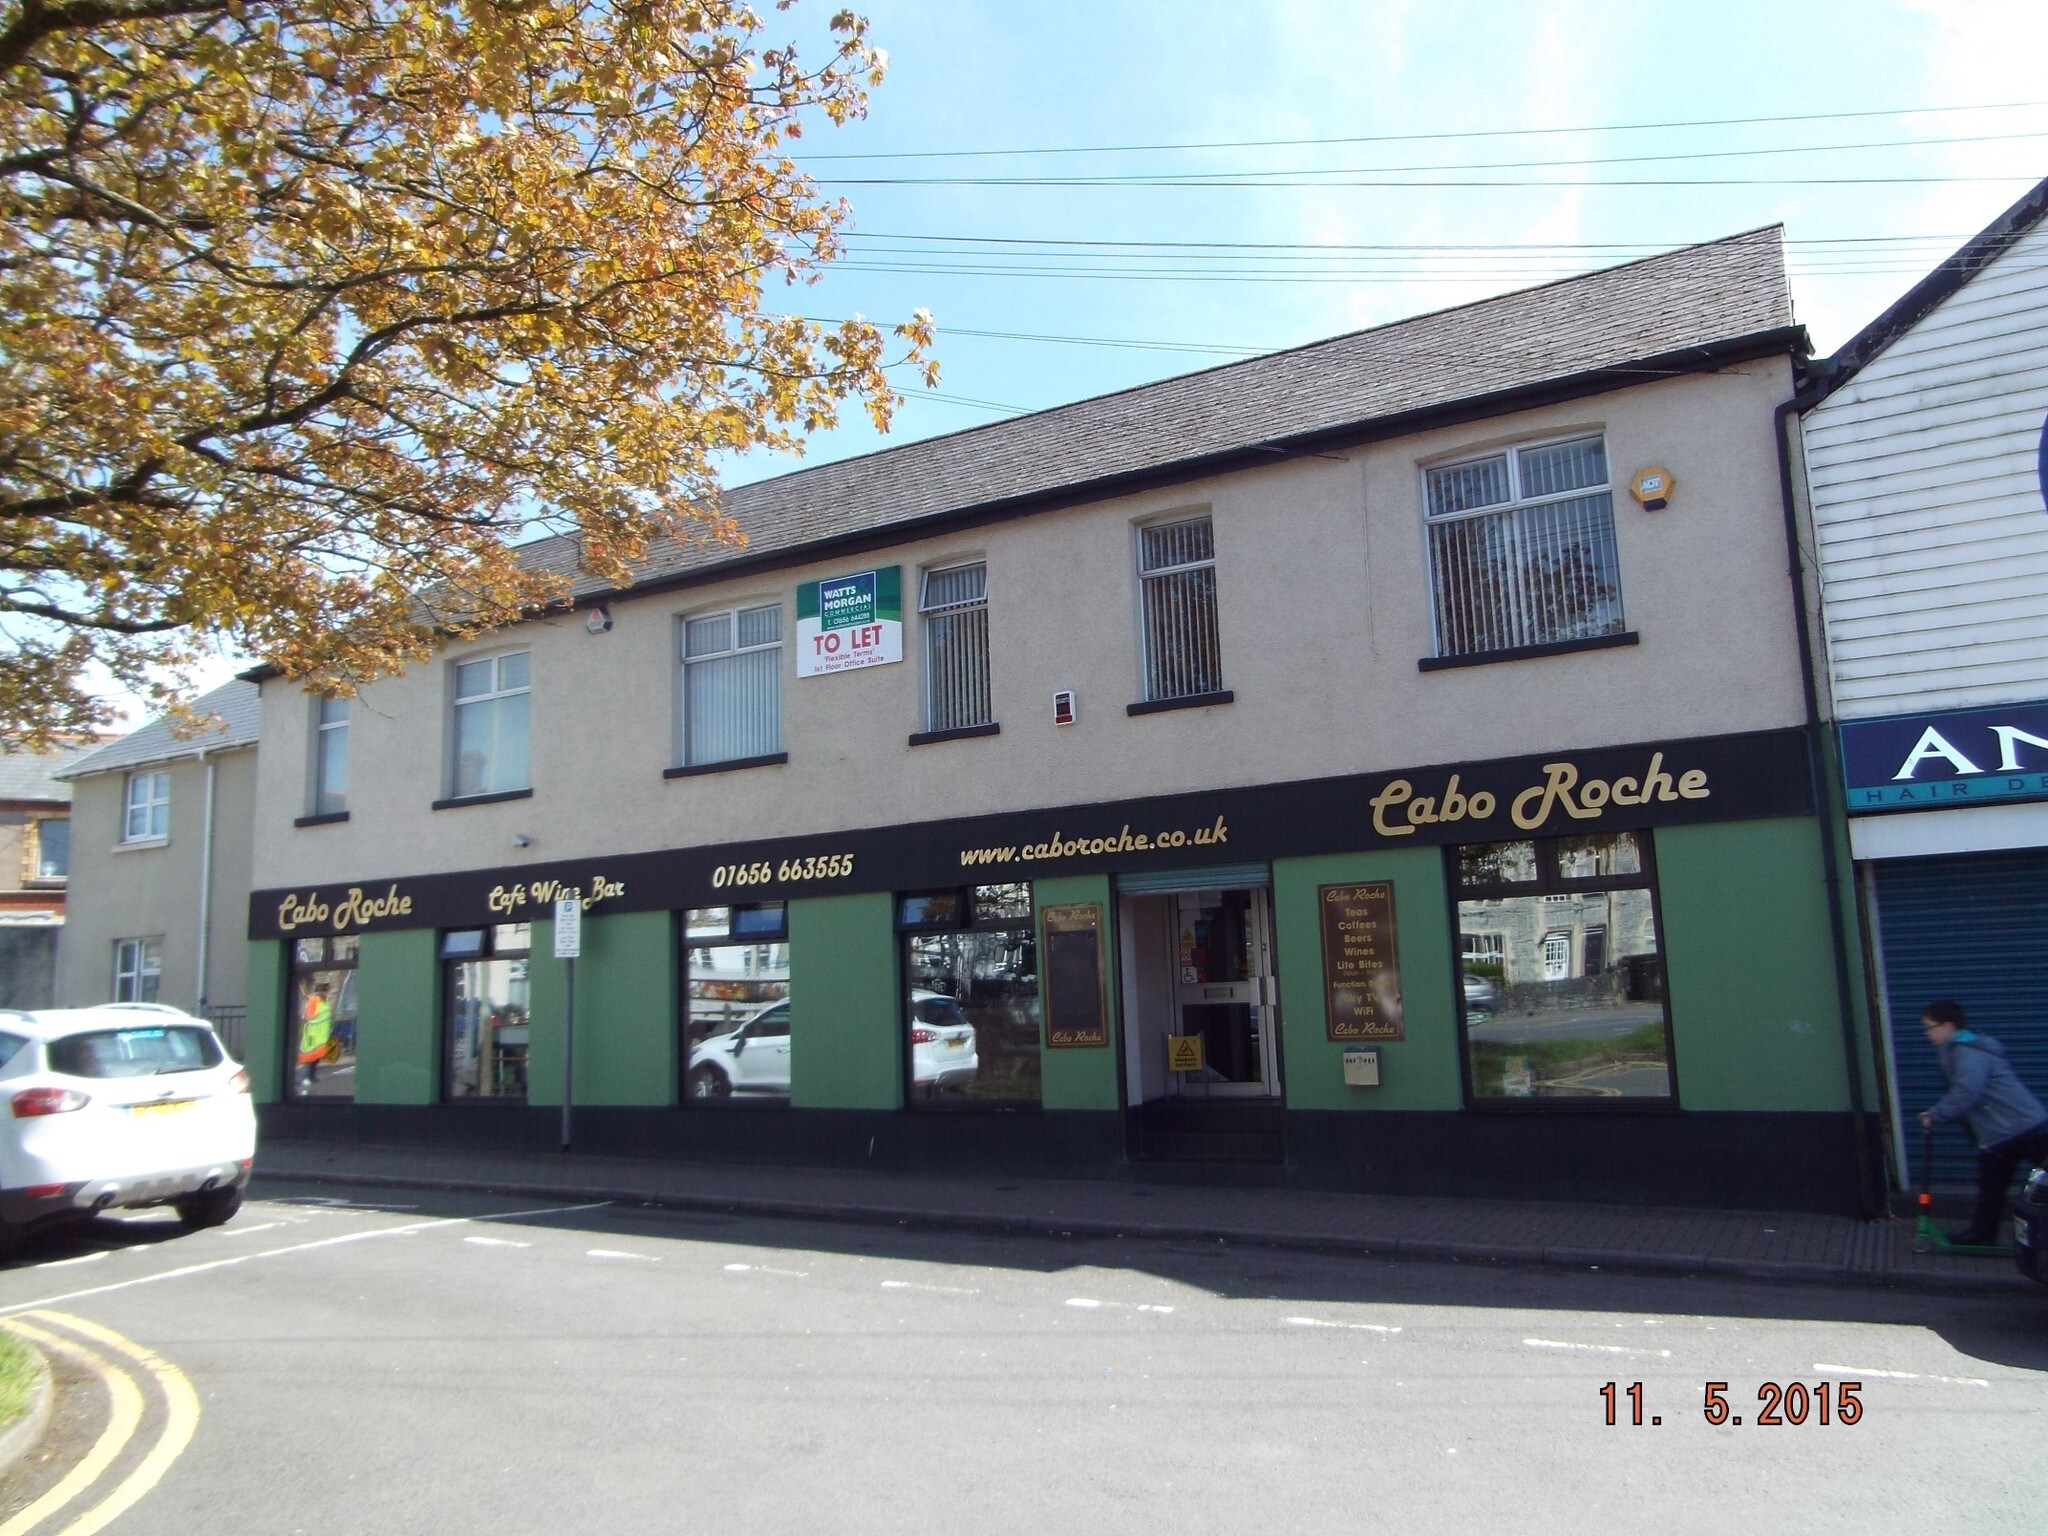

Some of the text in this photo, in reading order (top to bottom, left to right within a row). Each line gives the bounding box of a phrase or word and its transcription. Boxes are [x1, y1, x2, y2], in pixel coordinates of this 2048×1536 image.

[824, 586, 856, 599] WATTS
[824, 593, 871, 611] MORGAN
[824, 604, 871, 617] COMMERCIAL
[813, 633, 841, 656] TO
[851, 625, 883, 649] LET
[814, 655, 884, 673] 1st Floor Office Suite
[1369, 752, 1710, 837] Cabo Roche
[1866, 782, 1969, 802] HAIR
[959, 815, 1228, 866] www.caboroche.co.uk
[712, 853, 855, 889] 01656 663555
[488, 884, 527, 915] Café
[582, 875, 626, 911] Bar
[1326, 887, 1385, 902] Cabo Roche
[278, 884, 413, 931] Cabo Roche
[1345, 908, 1368, 917] Teas
[1338, 921, 1377, 930] Coffees
[1344, 934, 1372, 943] Beers
[1344, 947, 1375, 956] Wines
[1337, 960, 1383, 970] Lite Bites
[1333, 981, 1366, 989] Function
[1366, 992, 1380, 1002] TV
[1353, 1006, 1374, 1016] WiFi
[1335, 1022, 1395, 1035] Cabo Roche
[1052, 1031, 1102, 1042] Cabo Roche
